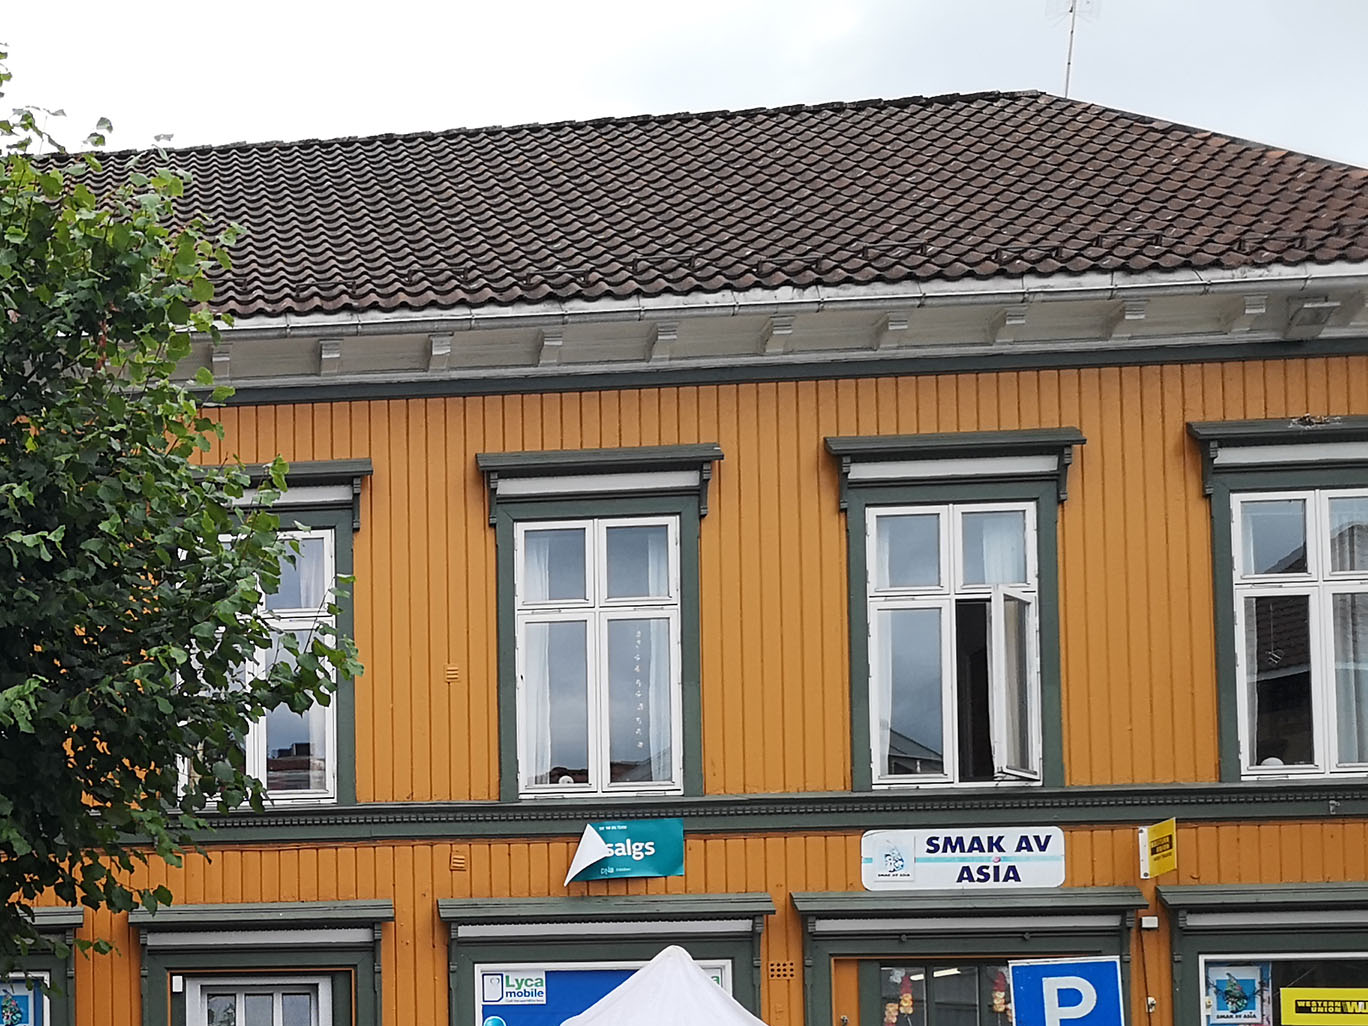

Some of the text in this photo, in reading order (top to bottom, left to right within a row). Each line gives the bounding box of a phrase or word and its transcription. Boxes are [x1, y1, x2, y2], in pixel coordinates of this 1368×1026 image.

[925, 835, 1053, 854] SMAK AV
[955, 857, 1022, 883] ASIA
[505, 975, 545, 993] Lyca
[505, 988, 545, 998] mobile
